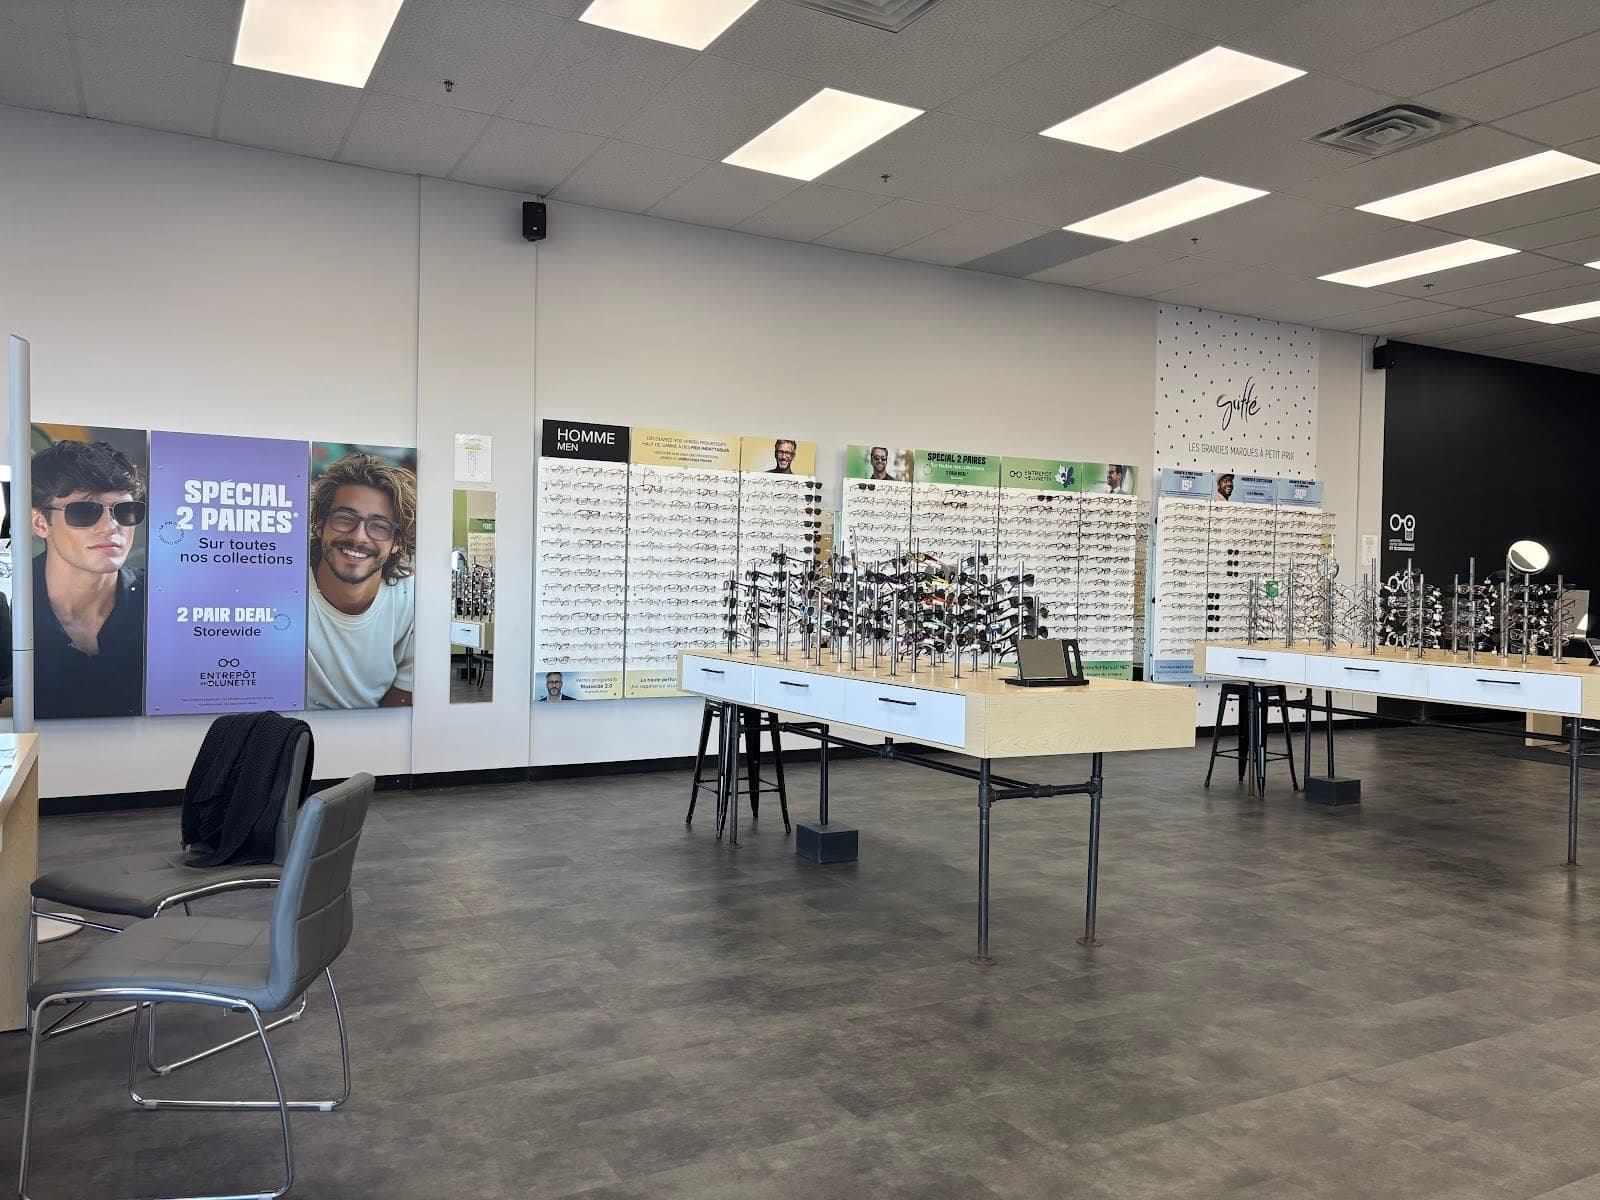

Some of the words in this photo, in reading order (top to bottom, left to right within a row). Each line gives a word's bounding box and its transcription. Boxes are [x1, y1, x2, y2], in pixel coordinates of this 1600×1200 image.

[557, 428, 616, 445] HOMME
[557, 442, 579, 452] MEN
[1188, 442, 1200, 453] LES
[1201, 443, 1229, 456] GRANDES
[1230, 446, 1259, 458] MARQUES
[1265, 449, 1281, 459] PETIT
[1281, 450, 1296, 461] PRIX
[956, 455, 962, 464] 2
[184, 479, 293, 508] SPÉCIAL
[176, 506, 194, 531] 2
[198, 537, 225, 549] Sur
[229, 538, 277, 551] toutes
[180, 552, 208, 563] nos
[213, 552, 293, 565] collections
[177, 606, 189, 622] 2
[192, 607, 231, 623] PAIR
[193, 626, 262, 637] Storewide
[200, 669, 257, 680] ENTREPÔT
